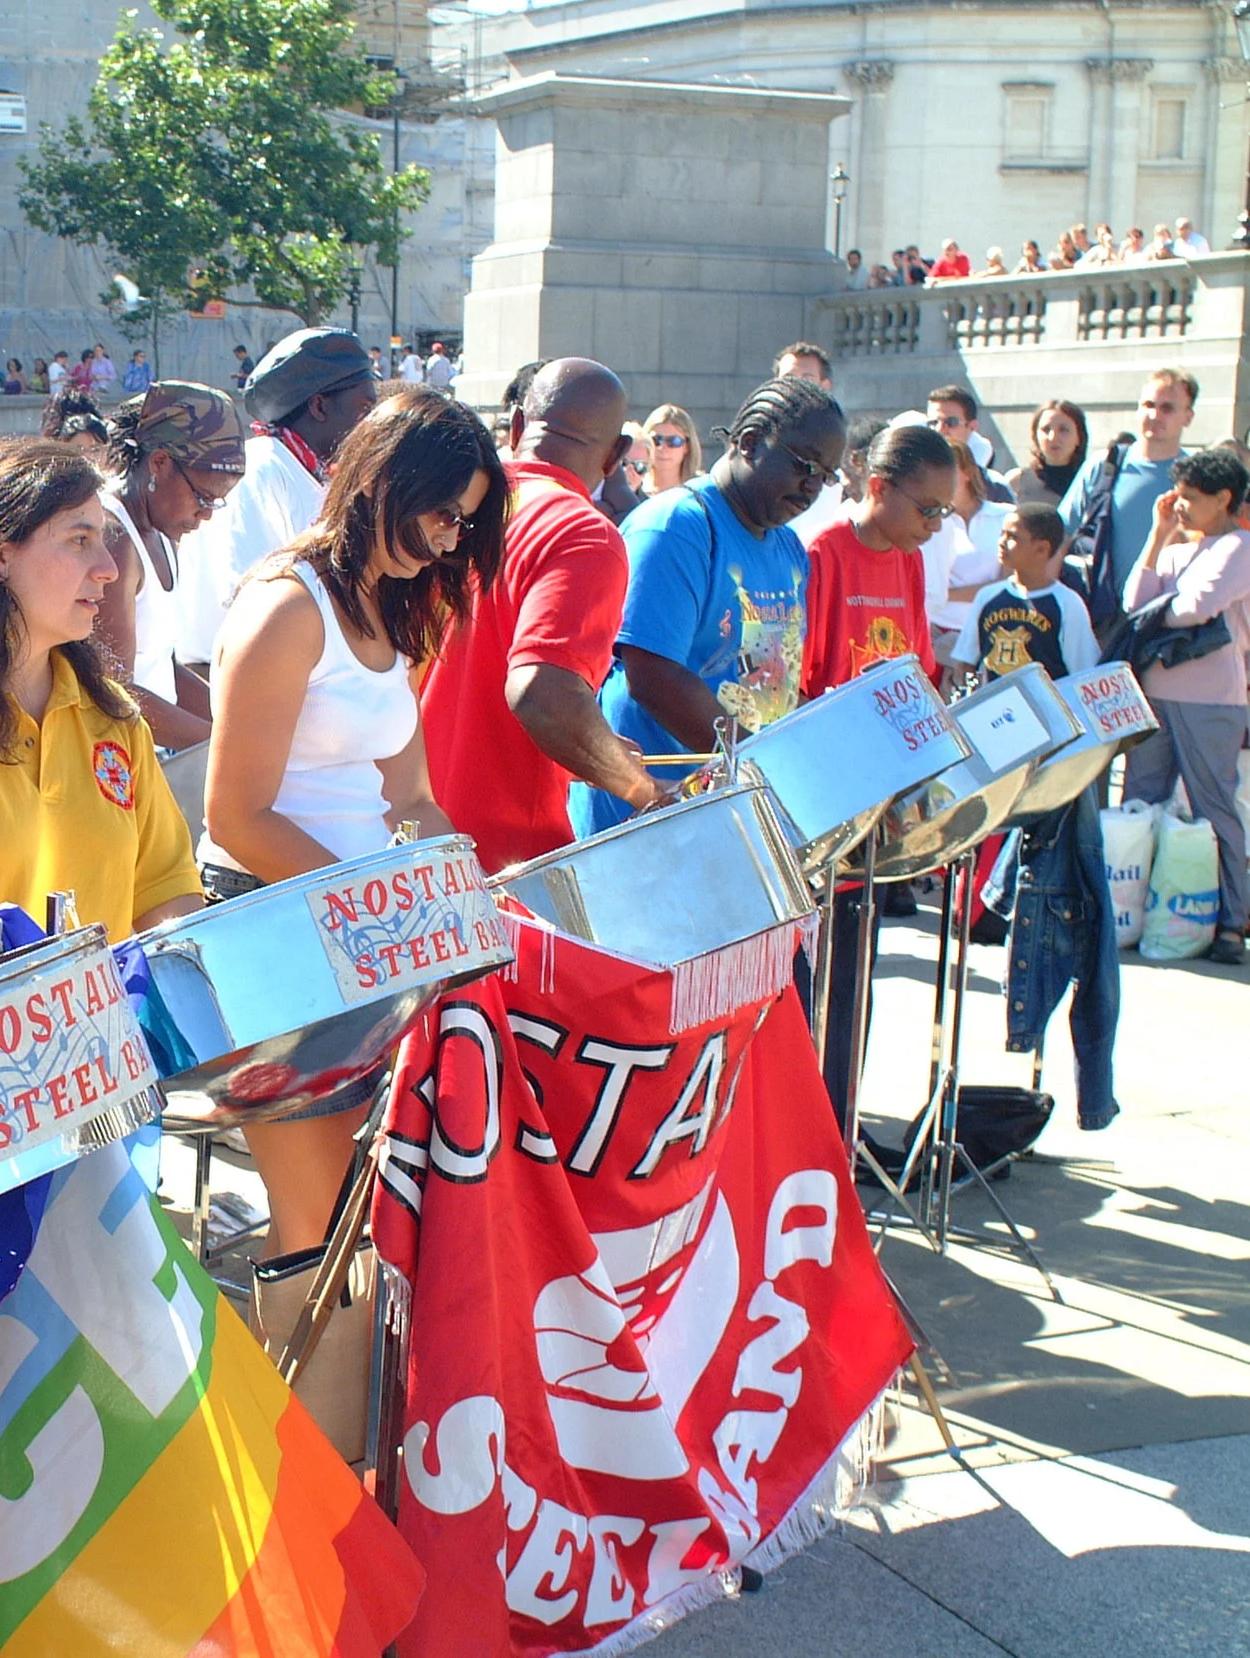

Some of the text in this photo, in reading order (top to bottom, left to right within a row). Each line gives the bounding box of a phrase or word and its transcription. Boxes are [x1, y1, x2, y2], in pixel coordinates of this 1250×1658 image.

[999, 640, 1017, 663] H
[872, 674, 920, 716] NOS
[355, 919, 504, 988] STEEL BA
